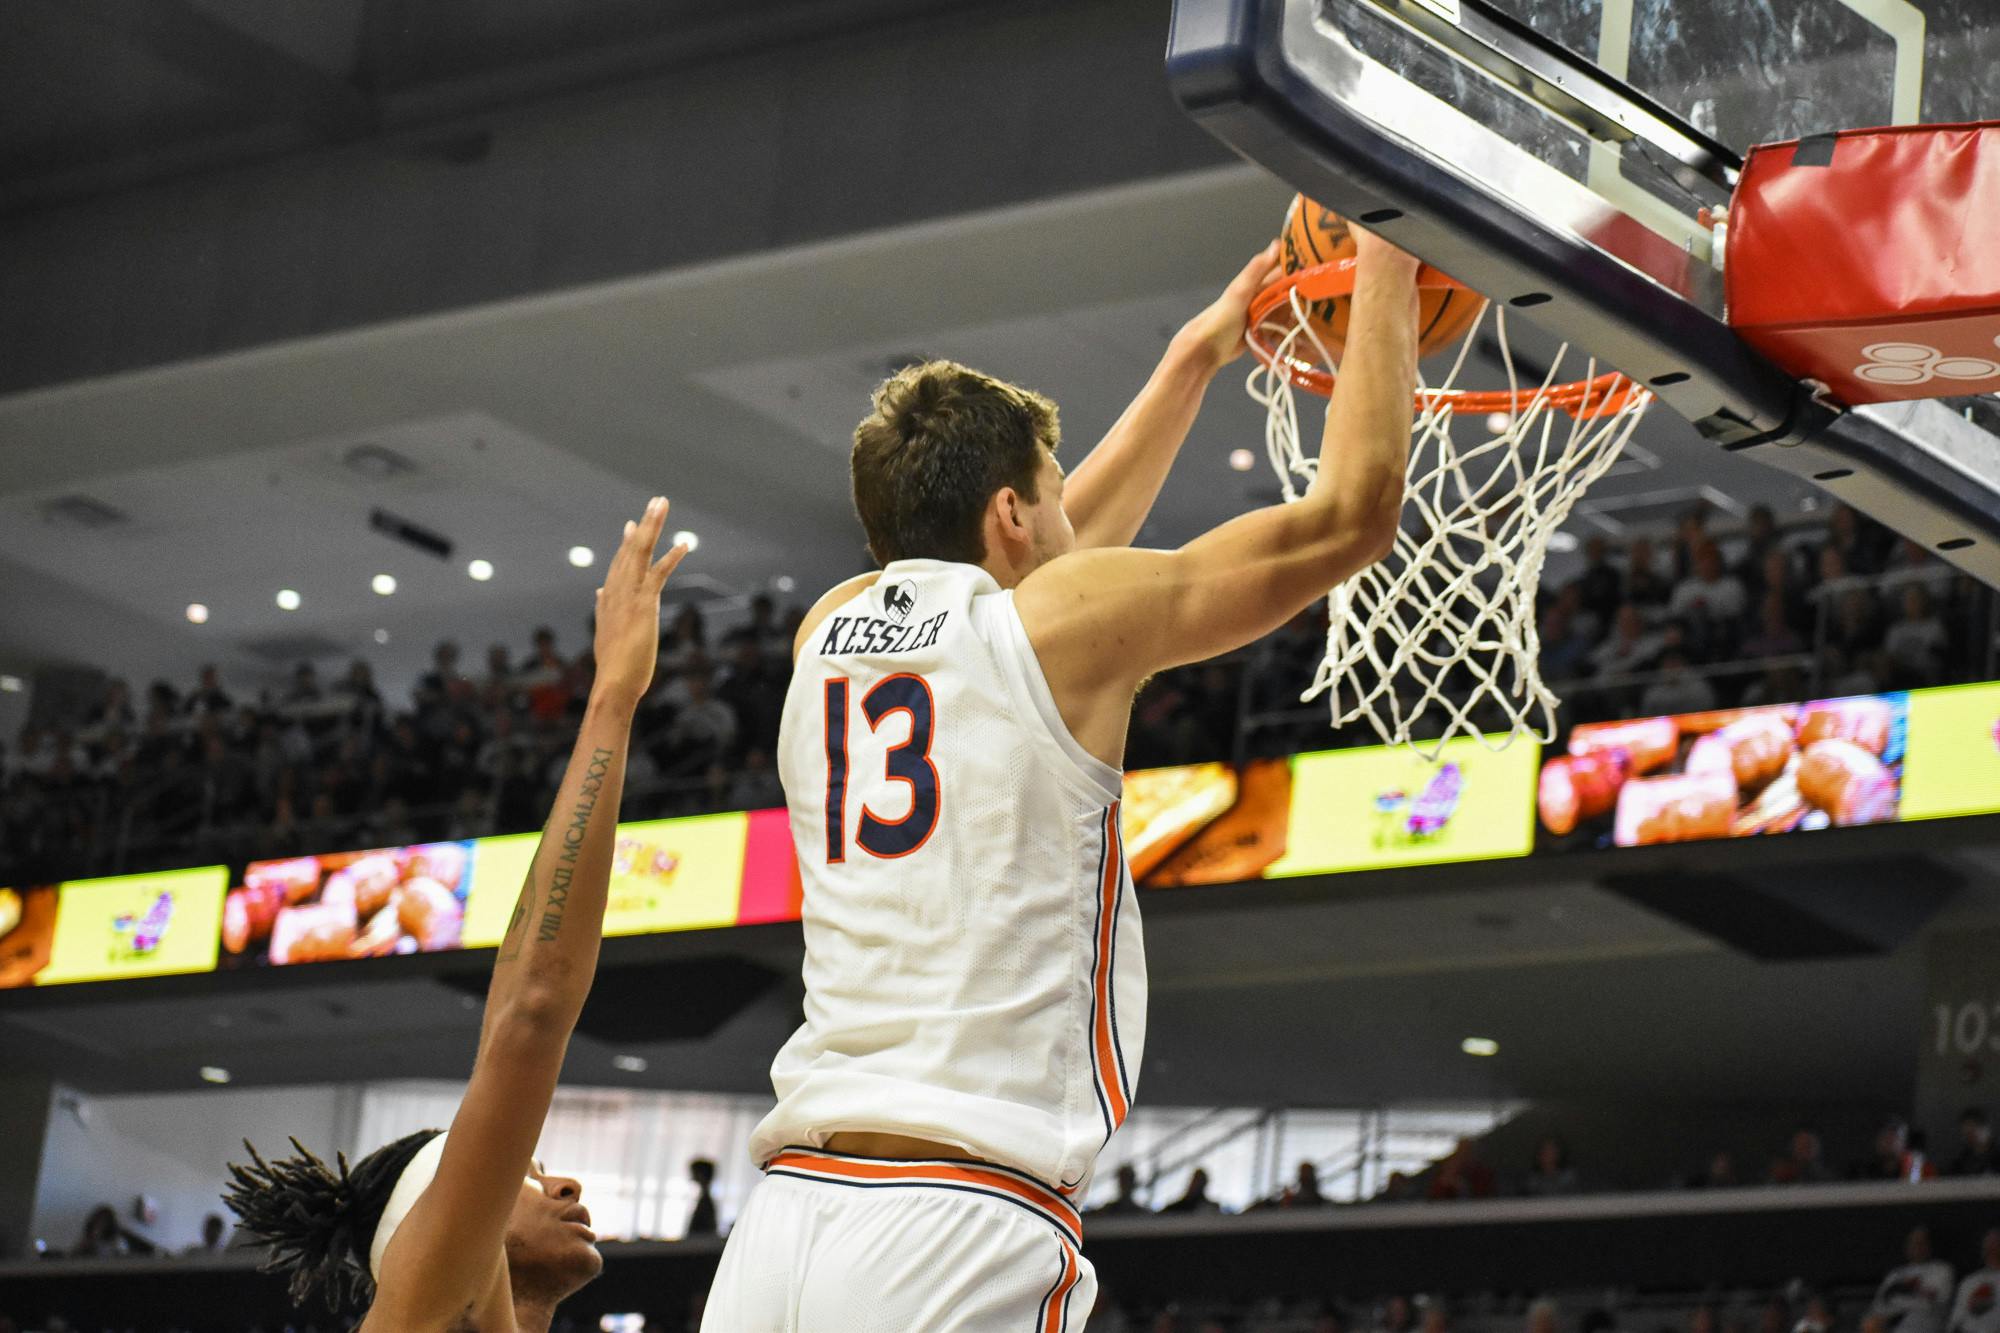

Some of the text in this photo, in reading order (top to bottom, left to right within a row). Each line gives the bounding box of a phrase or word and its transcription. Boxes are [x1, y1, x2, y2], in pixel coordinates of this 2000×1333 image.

[819, 610, 949, 656] KESSLER
[560, 748, 614, 863] MCMLXXXI
[824, 672, 941, 864] 13
[547, 868, 574, 910] XXII
